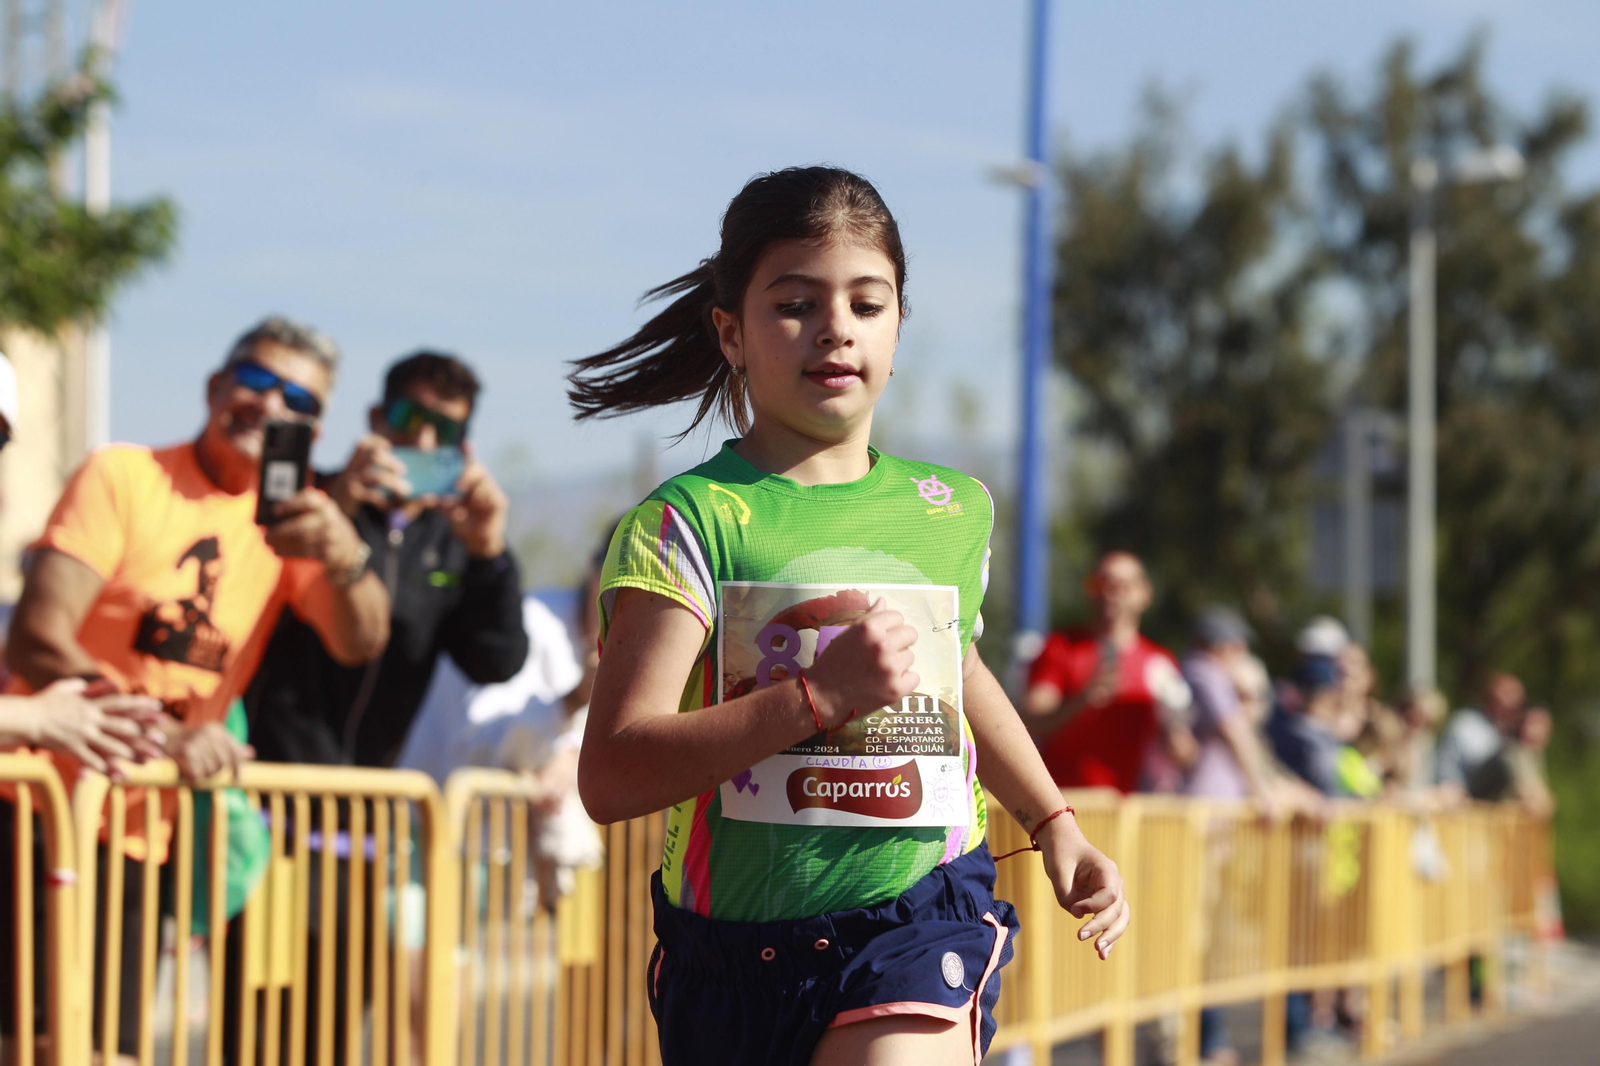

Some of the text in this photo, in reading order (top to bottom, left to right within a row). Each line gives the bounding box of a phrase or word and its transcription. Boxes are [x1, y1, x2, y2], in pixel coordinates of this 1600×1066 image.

[866, 716, 944, 725] CARRERA
[867, 727, 944, 735] POPULAR
[865, 736, 882, 744] CD.
[814, 745, 840, 753] 2024
[865, 743, 944, 754] DEL ALQUIÁN
[806, 755, 868, 769] CLAUDIA
